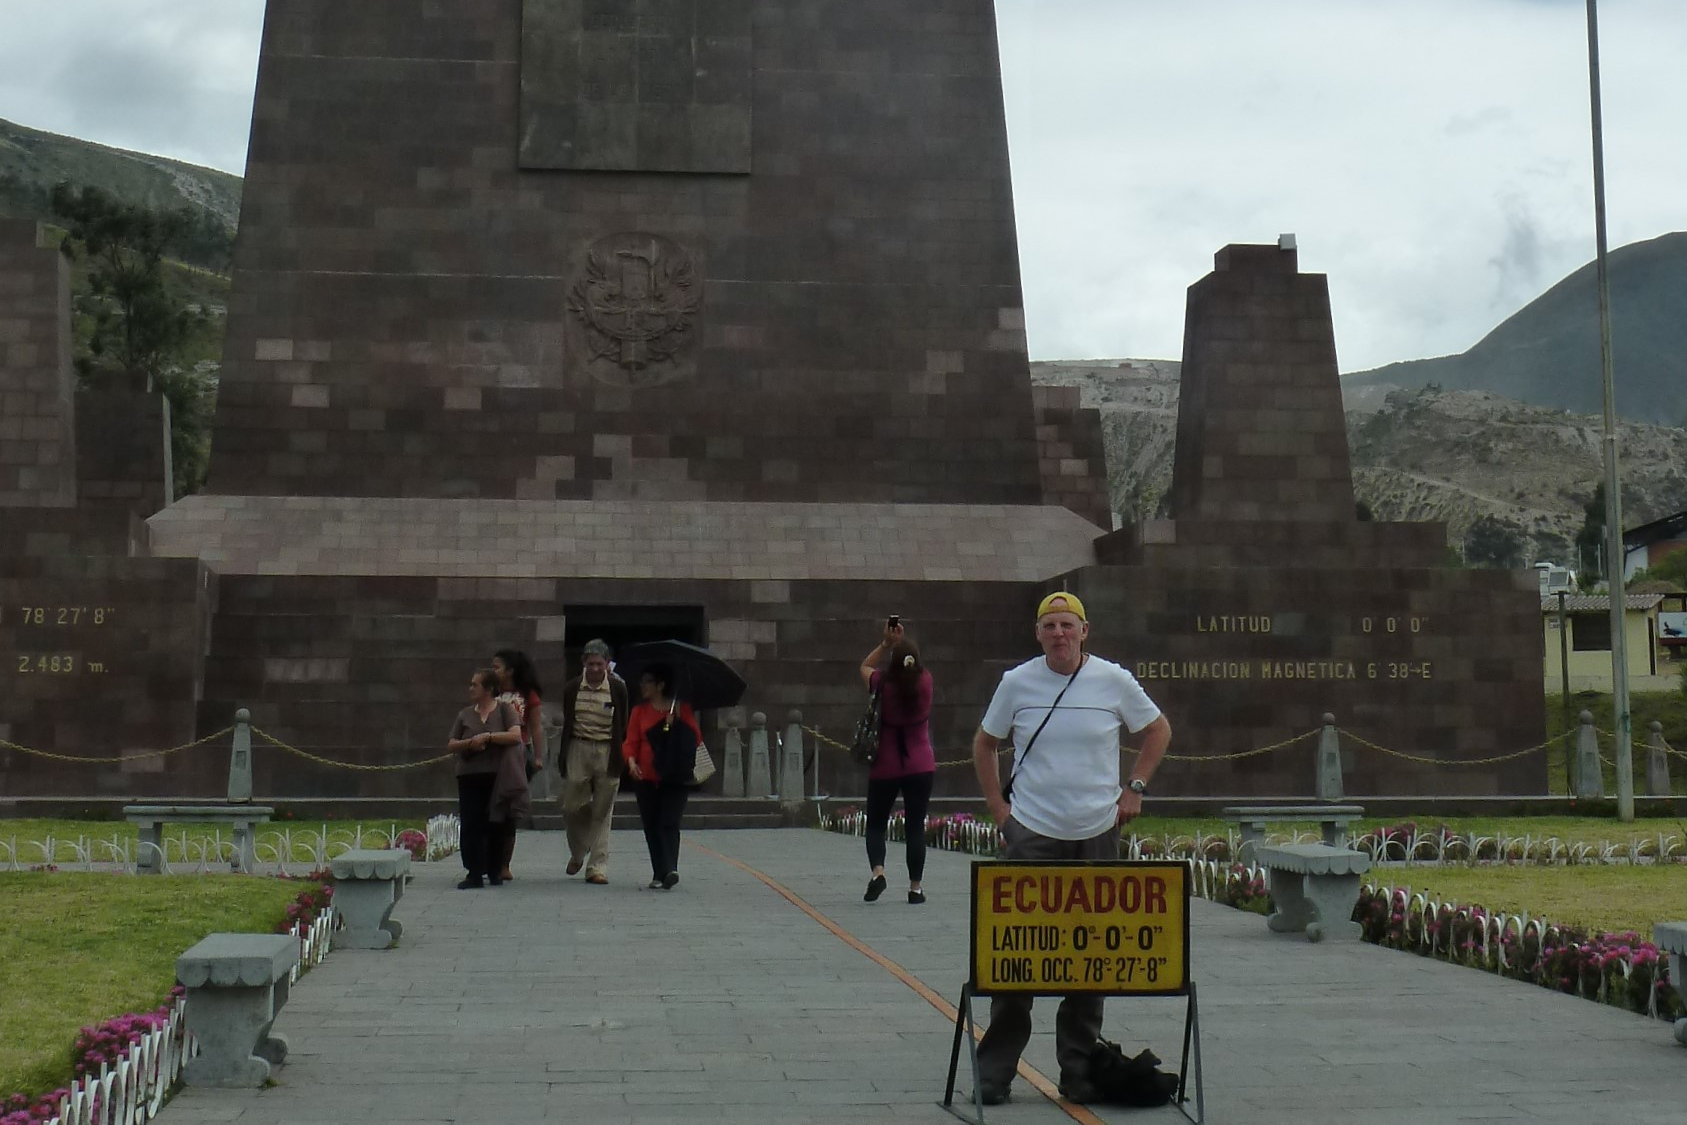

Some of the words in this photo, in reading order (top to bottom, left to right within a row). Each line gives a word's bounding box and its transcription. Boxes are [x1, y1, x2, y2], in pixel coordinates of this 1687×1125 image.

[1197, 614, 1271, 633] LATITUD
[18, 655, 74, 673] 2.483
[1136, 661, 1251, 679] DECLINACION
[1261, 661, 1356, 679] MAGNETICA
[992, 875, 1167, 914] ECUADOR
[992, 925, 1067, 951] LATITUD:
[991, 957, 1036, 983] LONG.
[1041, 958, 1078, 983] OCC.
